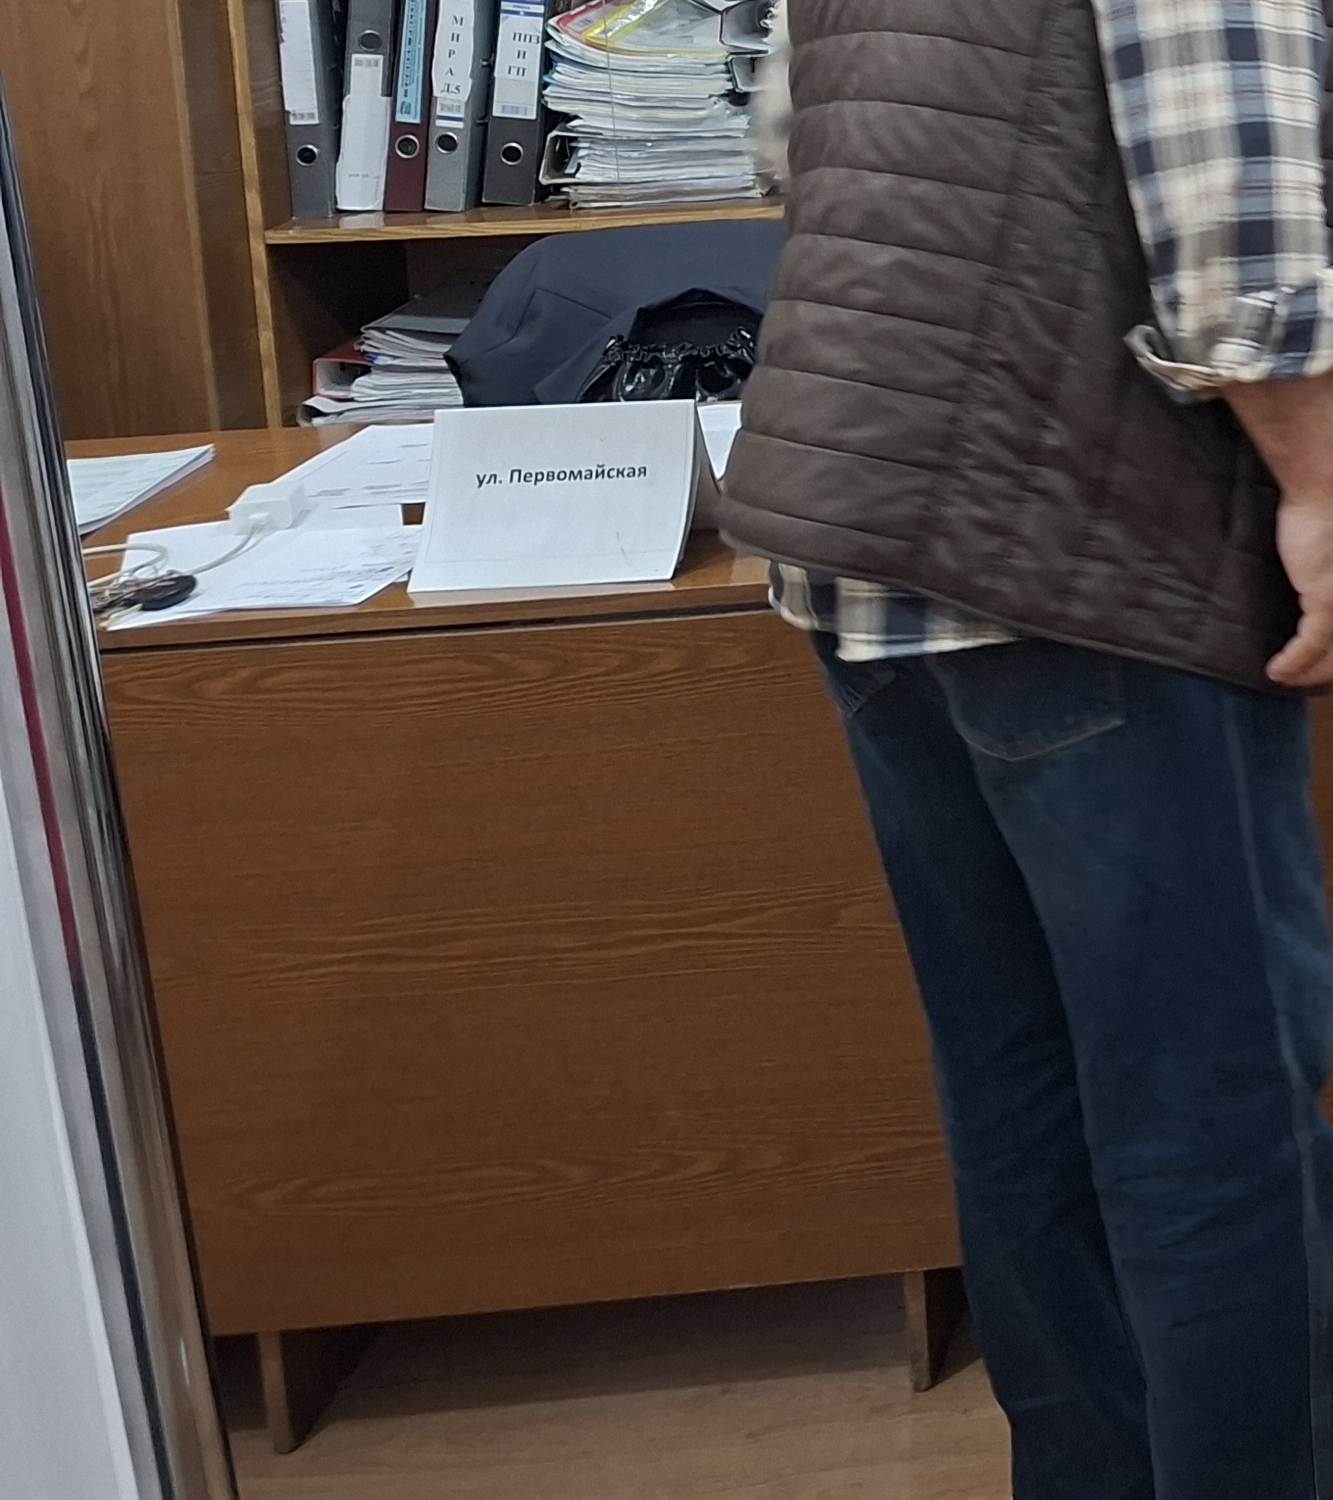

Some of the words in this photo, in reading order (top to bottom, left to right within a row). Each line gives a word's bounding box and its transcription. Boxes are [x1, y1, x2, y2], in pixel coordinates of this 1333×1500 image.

[512, 31, 540, 45] ППЗ
[507, 65, 527, 77] ГП
[475, 472, 503, 488] ул.
[509, 464, 648, 487] Первомайская
